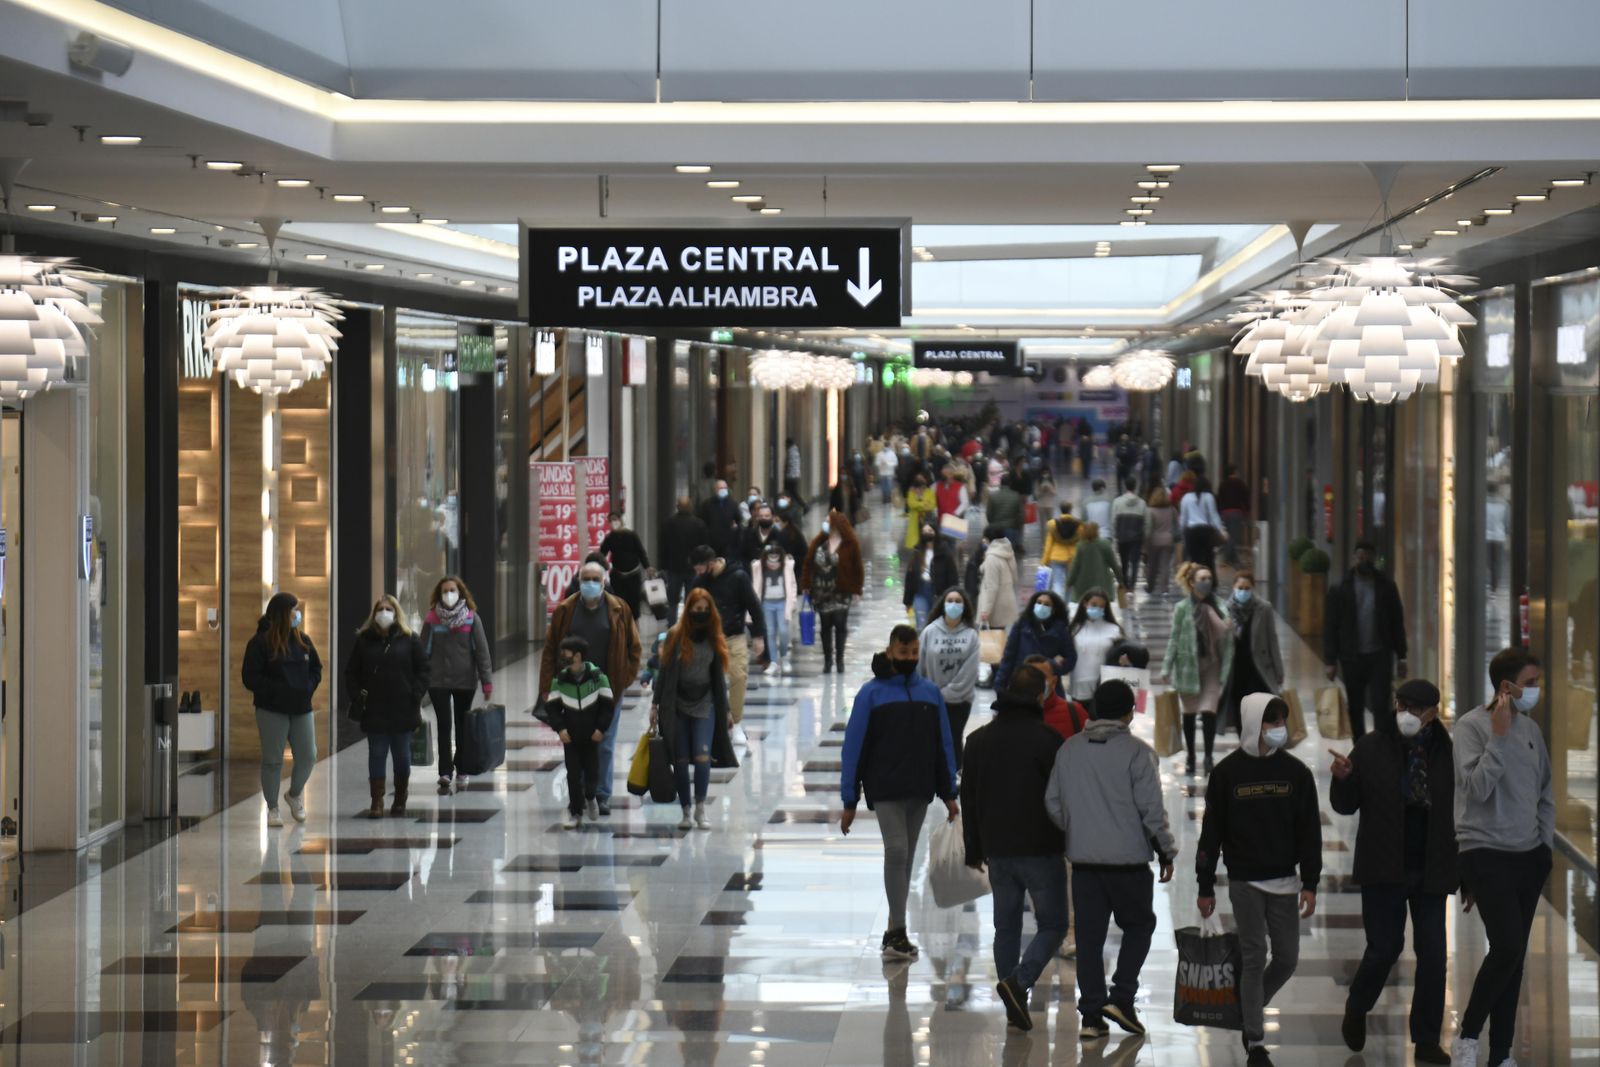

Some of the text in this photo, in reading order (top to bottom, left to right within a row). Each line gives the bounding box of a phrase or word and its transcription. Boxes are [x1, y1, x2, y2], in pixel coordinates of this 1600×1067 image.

[558, 246, 839, 272] PLAZA CENTRAL
[578, 286, 818, 308] PLAZA ALHAMBRA
[924, 350, 1005, 359] PLAZA CENTRAL
[1179, 960, 1235, 990] SNIPES
